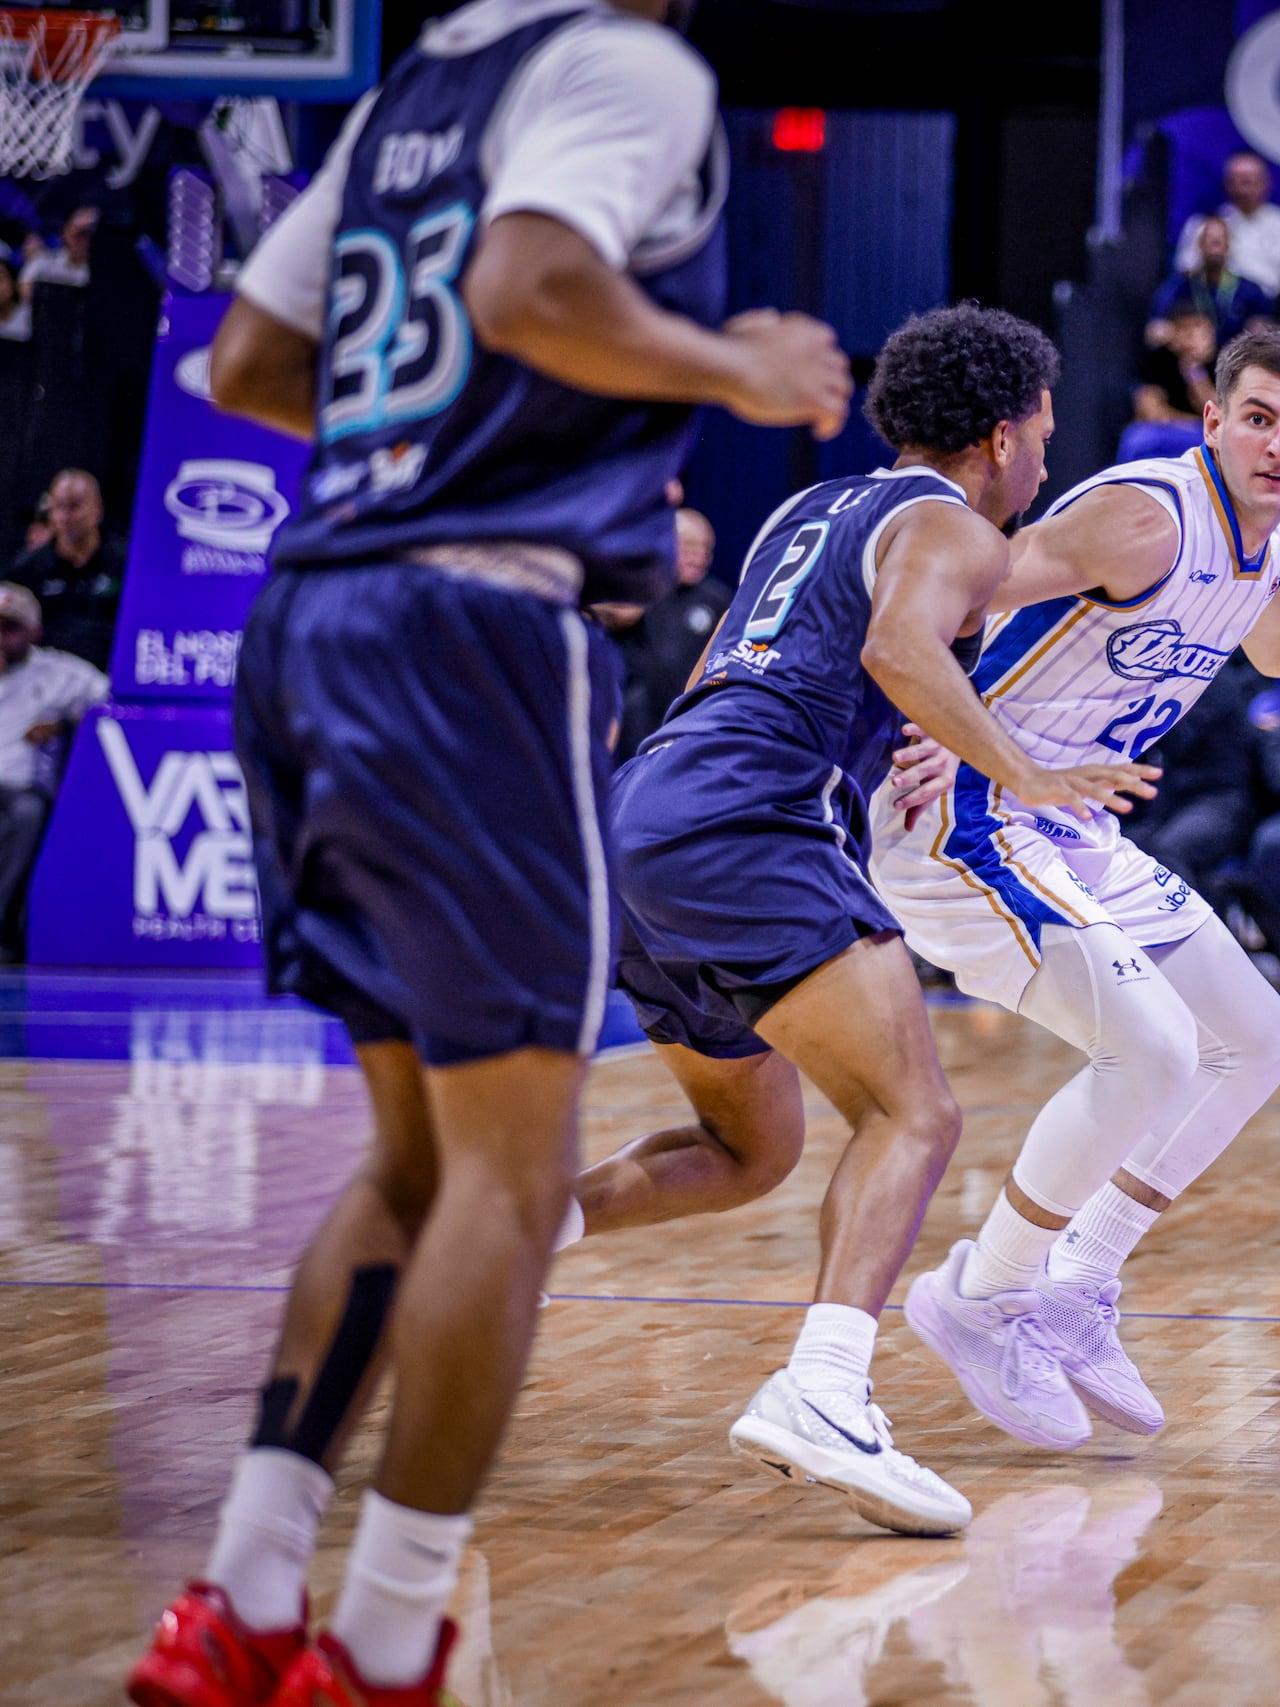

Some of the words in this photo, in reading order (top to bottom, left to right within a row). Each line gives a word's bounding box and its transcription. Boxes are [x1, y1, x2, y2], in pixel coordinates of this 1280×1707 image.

[321, 203, 474, 444] 23
[742, 520, 831, 640] 2
[1095, 694, 1182, 760] 22
